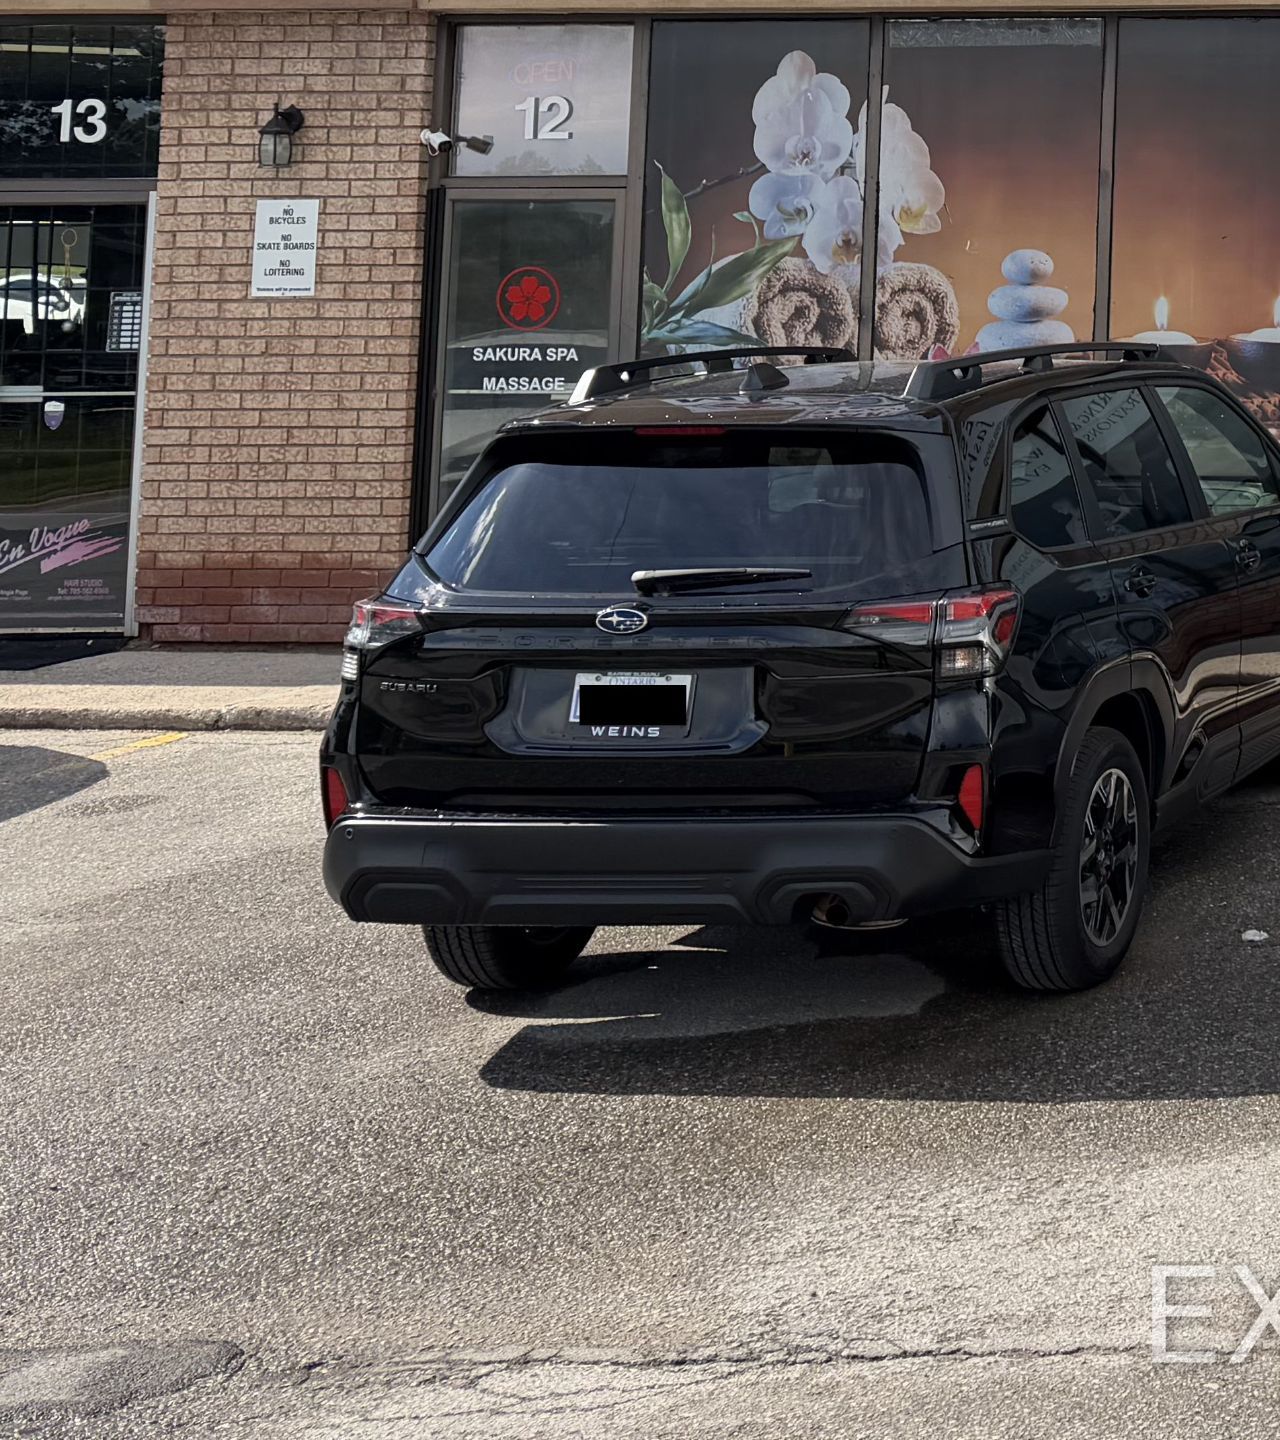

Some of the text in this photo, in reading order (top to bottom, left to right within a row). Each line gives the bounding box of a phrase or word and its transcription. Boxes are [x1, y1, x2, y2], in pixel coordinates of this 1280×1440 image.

[513, 60, 576, 84] OPEN
[50, 98, 107, 144] 13
[515, 95, 574, 140] 12
[282, 208, 294, 217] NO
[269, 216, 306, 225] BICYCLES
[280, 234, 292, 242] NO
[256, 242, 315, 251] SKATE BOARDS
[279, 259, 291, 268] NO
[264, 268, 305, 277] LOITERING
[472, 347, 579, 361] SAKURA SPA
[482, 377, 565, 391] MASSAGE
[28, 518, 91, 552] Vogue
[380, 681, 438, 693] SUBARU
[591, 726, 660, 737] WEINS
